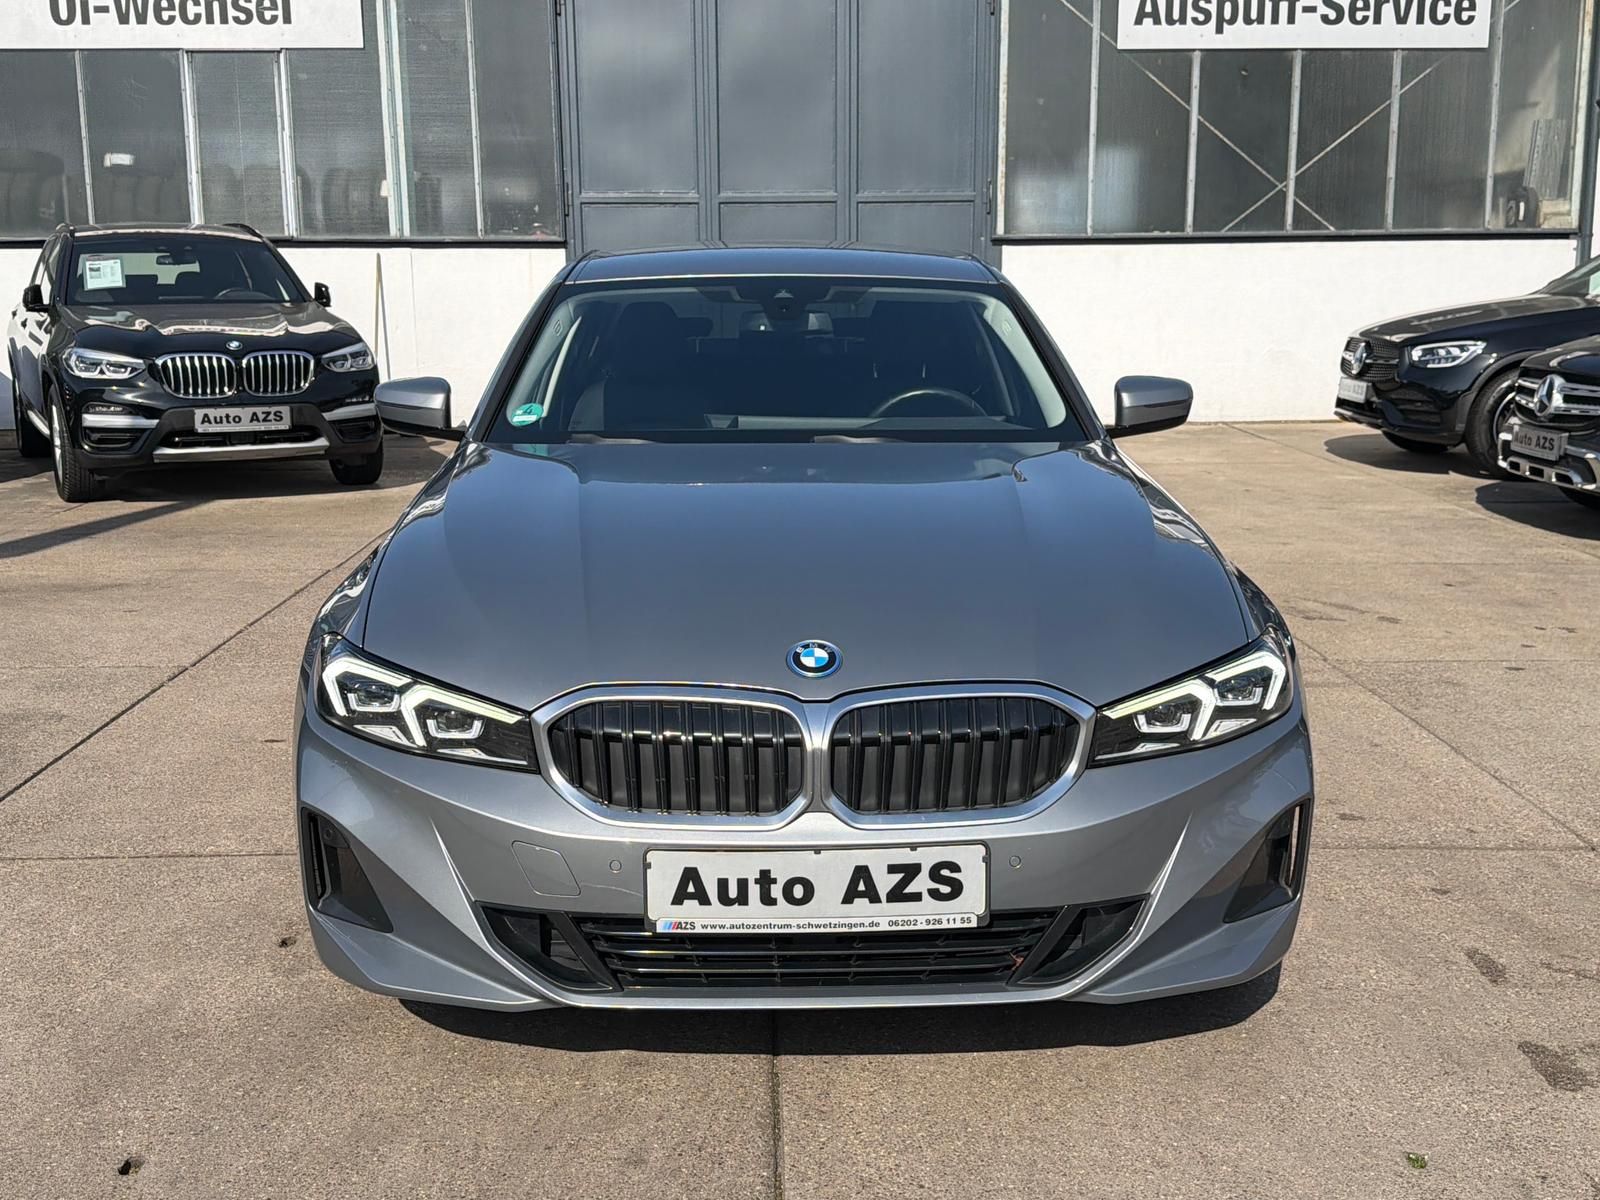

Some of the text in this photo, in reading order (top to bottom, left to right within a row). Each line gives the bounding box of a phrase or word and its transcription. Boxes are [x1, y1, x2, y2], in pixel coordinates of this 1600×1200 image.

[1133, 0, 1477, 35] Auspuff-Service
[201, 410, 284, 425] Auto AZS
[1535, 435, 1555, 451] AZS
[670, 860, 964, 907] Auto AZS
[700, 920, 881, 930] www.autozentrum-schwetzingen.de
[888, 919, 918, 927] 06202
[925, 918, 943, 926] 926
[946, 917, 957, 925] 11
[960, 916, 972, 924] 55
